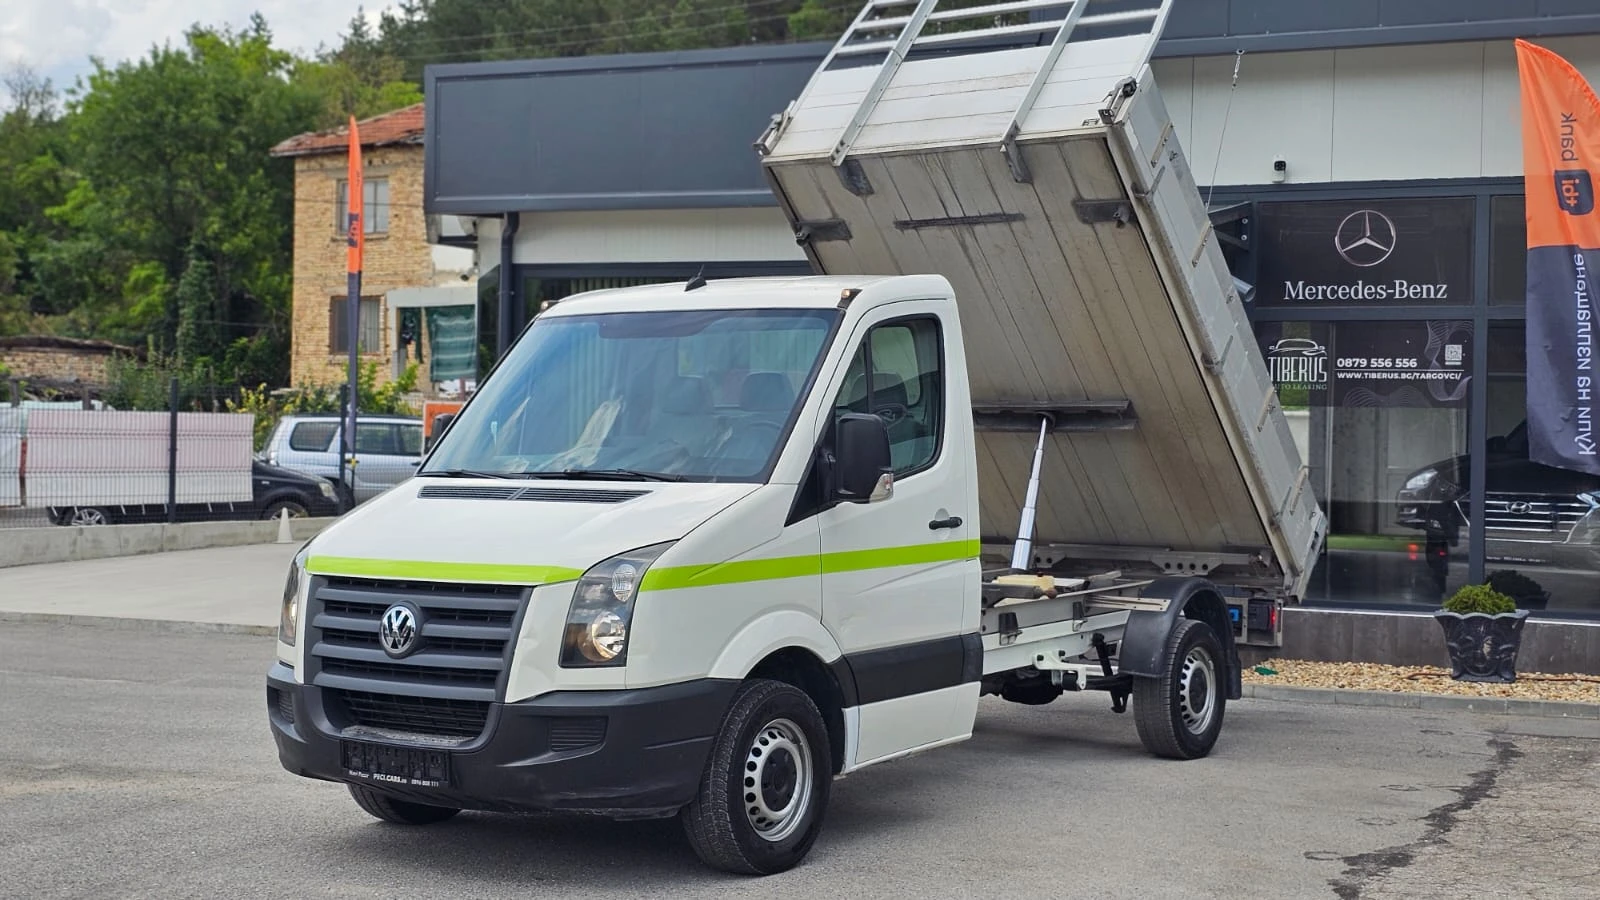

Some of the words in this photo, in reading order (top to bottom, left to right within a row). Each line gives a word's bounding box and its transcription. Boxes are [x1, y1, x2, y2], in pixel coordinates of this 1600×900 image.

[1283, 279, 1448, 300] Mercedes-Benz
[1267, 356, 1328, 382] TIBERUS
[1336, 358, 1367, 368] 0879
[1370, 358, 1392, 368] 556
[1395, 358, 1418, 368] 556
[1337, 372, 1462, 381] WWW.TIBERUS.BG/TARGOVCI/
